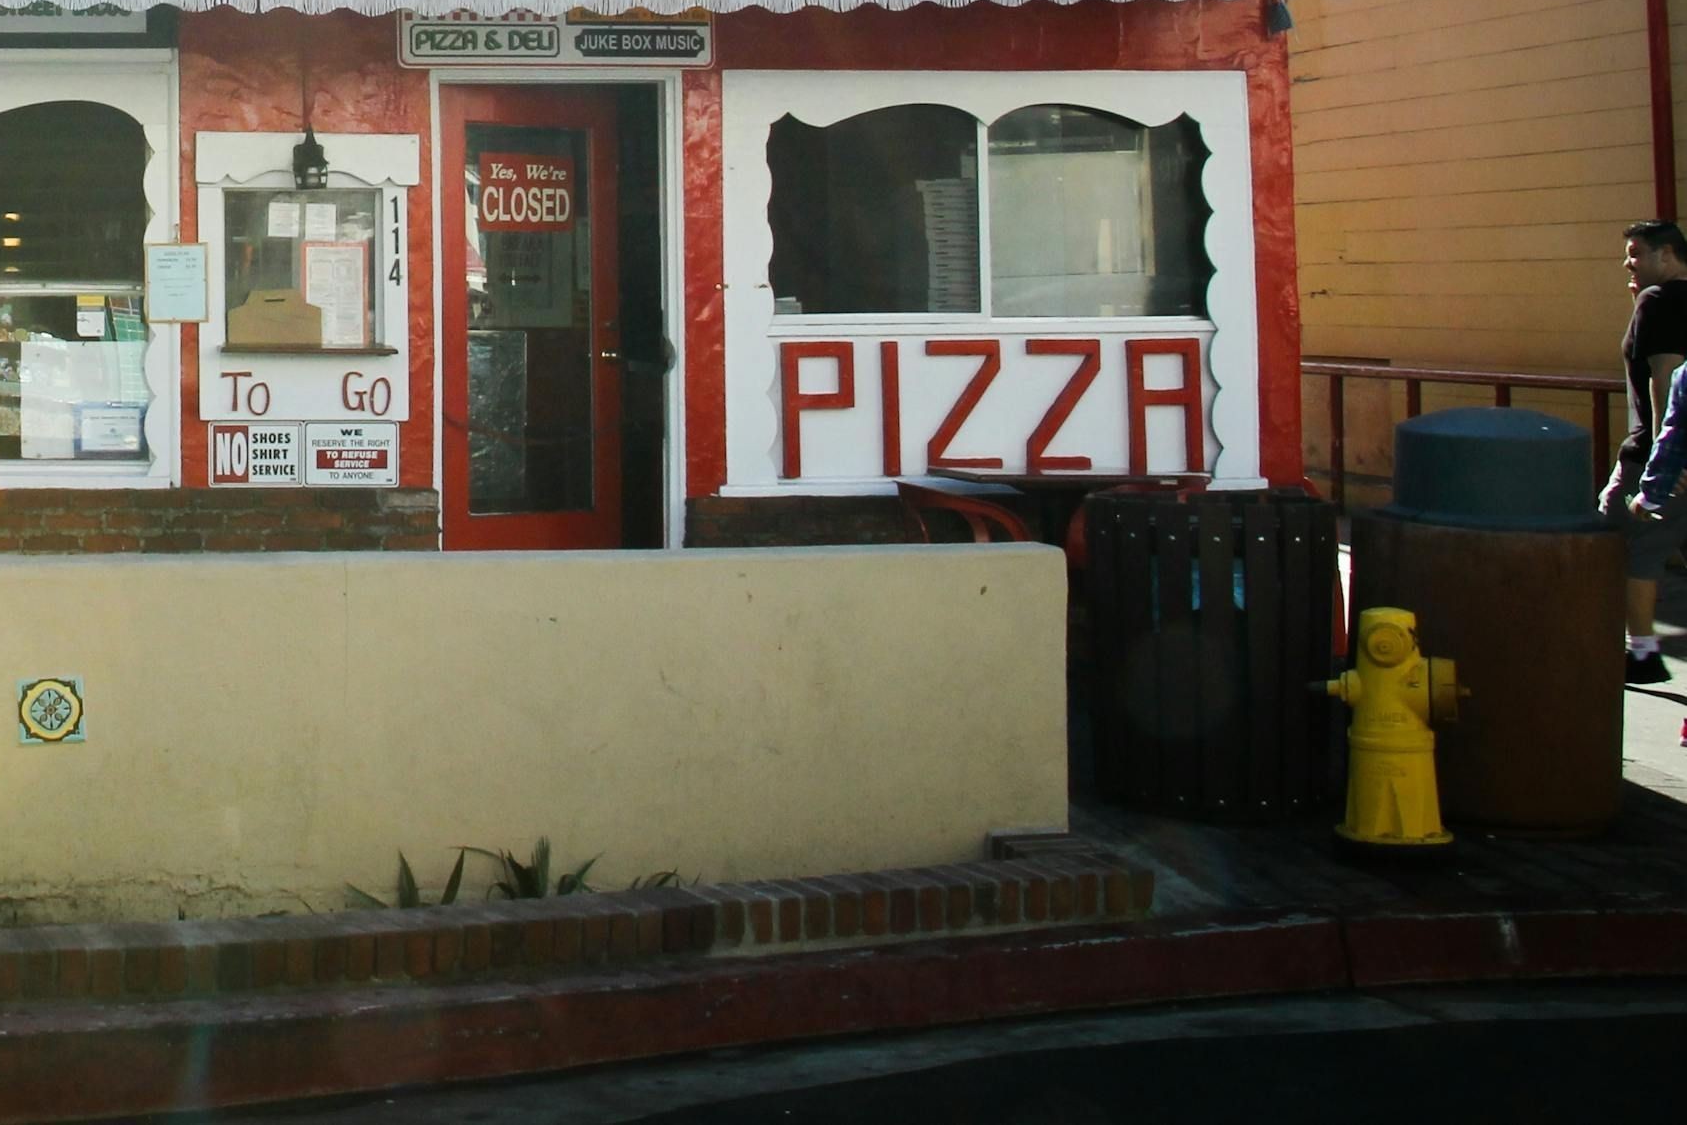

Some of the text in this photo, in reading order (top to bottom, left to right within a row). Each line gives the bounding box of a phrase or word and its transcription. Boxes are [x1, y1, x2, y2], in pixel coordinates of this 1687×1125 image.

[415, 29, 554, 51] PIZZA & DELI
[580, 34, 701, 51] JUKE BOX MUSIC
[489, 162, 567, 182] Yes, We're
[482, 185, 570, 222] CLOSED
[779, 338, 1205, 479] PIZZA
[251, 432, 291, 444] SHOES
[340, 428, 363, 437] WE
[311, 439, 391, 448] RESERVE THE RIGHT
[215, 432, 248, 477] NO
[251, 448, 289, 460] SHIRT
[325, 451, 378, 460] TO REFUSE
[251, 464, 296, 476] SERVICE
[333, 459, 370, 469] SERVICE
[329, 471, 340, 480] TO
[342, 471, 375, 480] ANYONE
